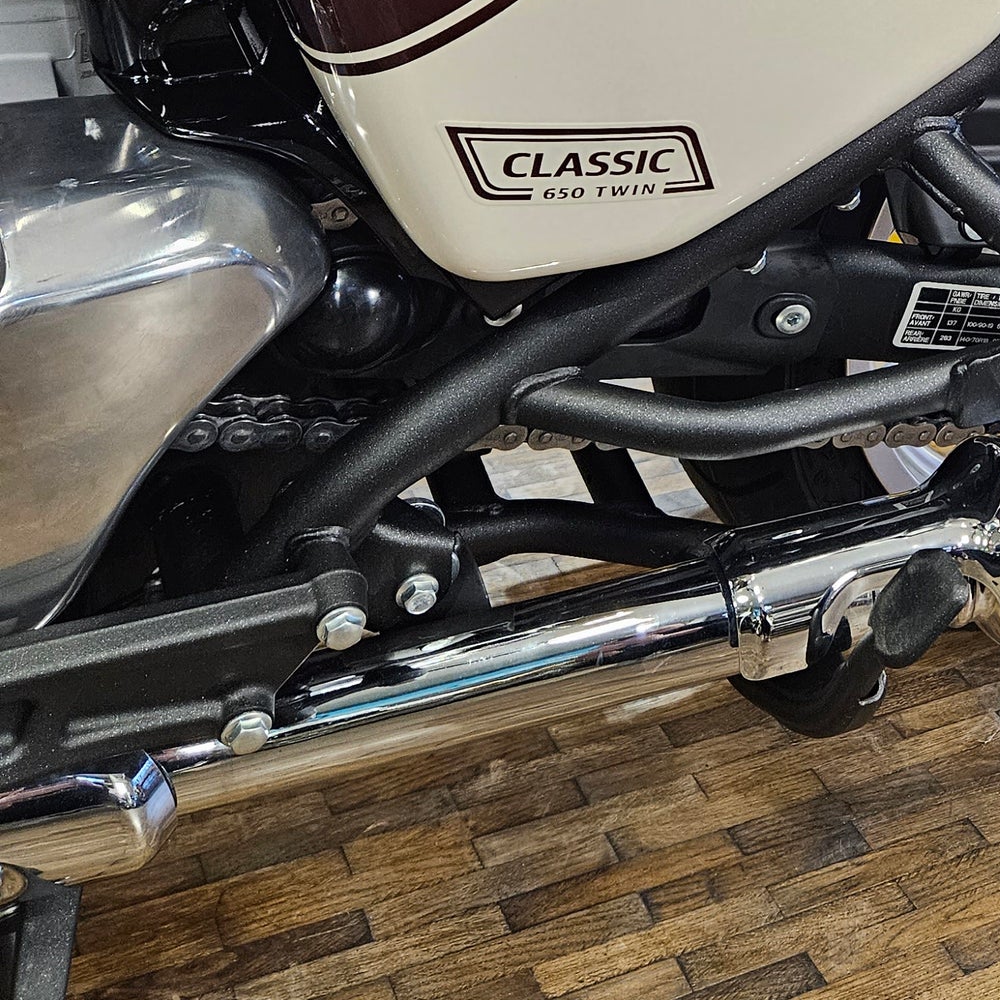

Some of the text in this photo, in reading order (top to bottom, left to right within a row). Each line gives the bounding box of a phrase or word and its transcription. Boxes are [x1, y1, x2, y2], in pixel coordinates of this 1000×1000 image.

[502, 149, 675, 178] CLASSIC
[543, 183, 656, 200] 650 TWIN
